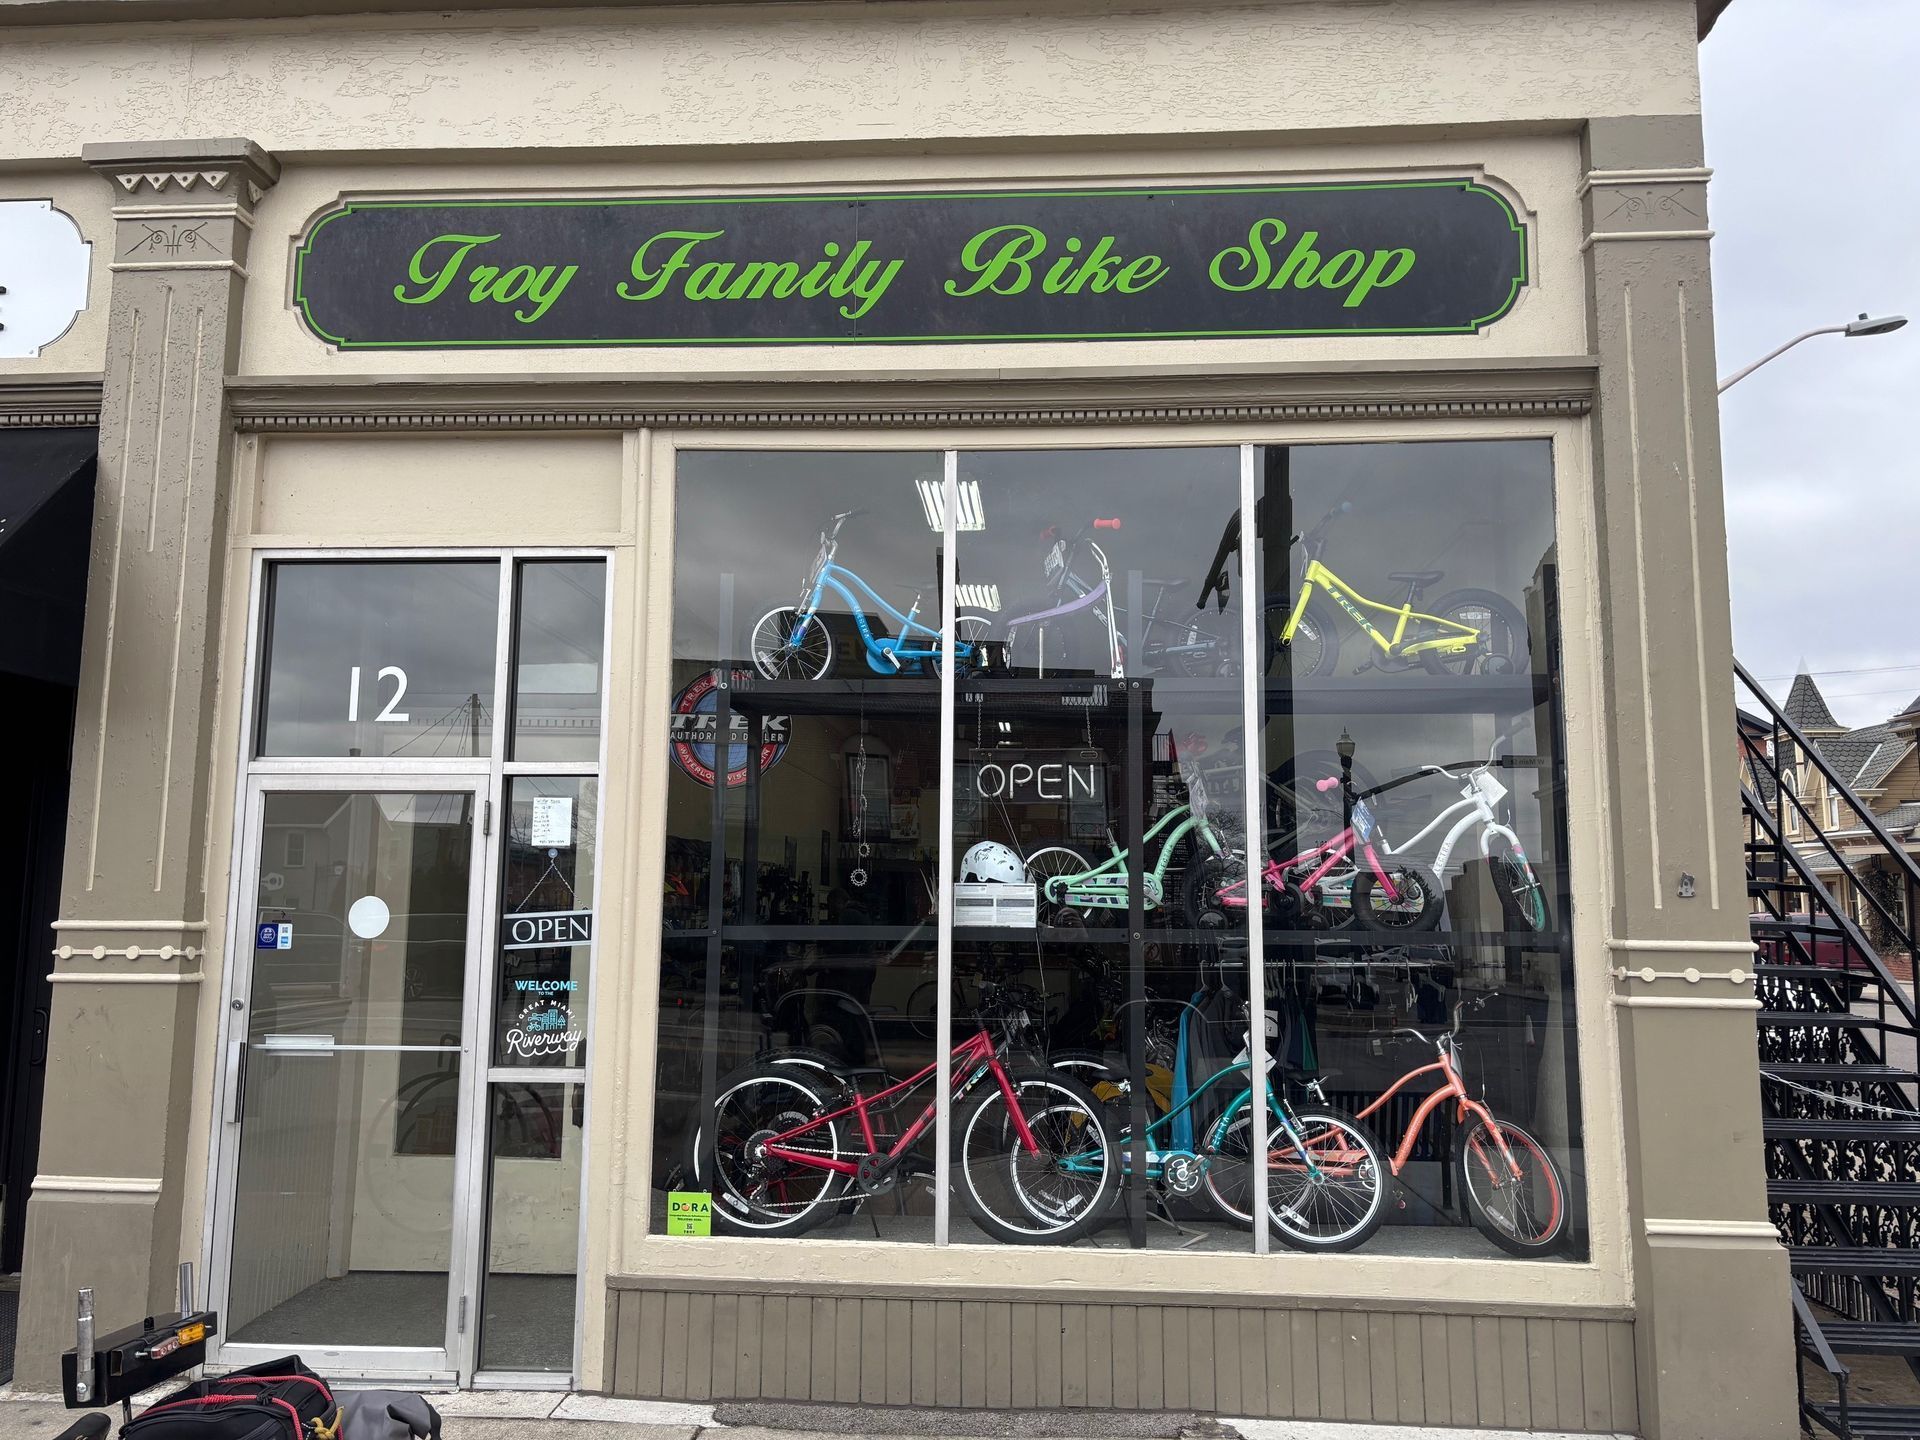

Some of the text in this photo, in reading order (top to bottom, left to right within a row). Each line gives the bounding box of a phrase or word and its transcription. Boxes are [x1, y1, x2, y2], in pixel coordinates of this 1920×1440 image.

[393, 218, 1417, 323] Troy Family Bike Shop
[1327, 586, 1374, 634] TREK
[348, 665, 410, 722] 12
[670, 731, 783, 742] AUTHORID DLER
[976, 763, 1095, 799] OPEN
[512, 916, 589, 943] OPEN
[515, 980, 578, 991] WELCOME
[518, 999, 576, 1020] GREAT MIAMI
[506, 1028, 582, 1058] Riverway
[672, 1202, 709, 1212] DORA
